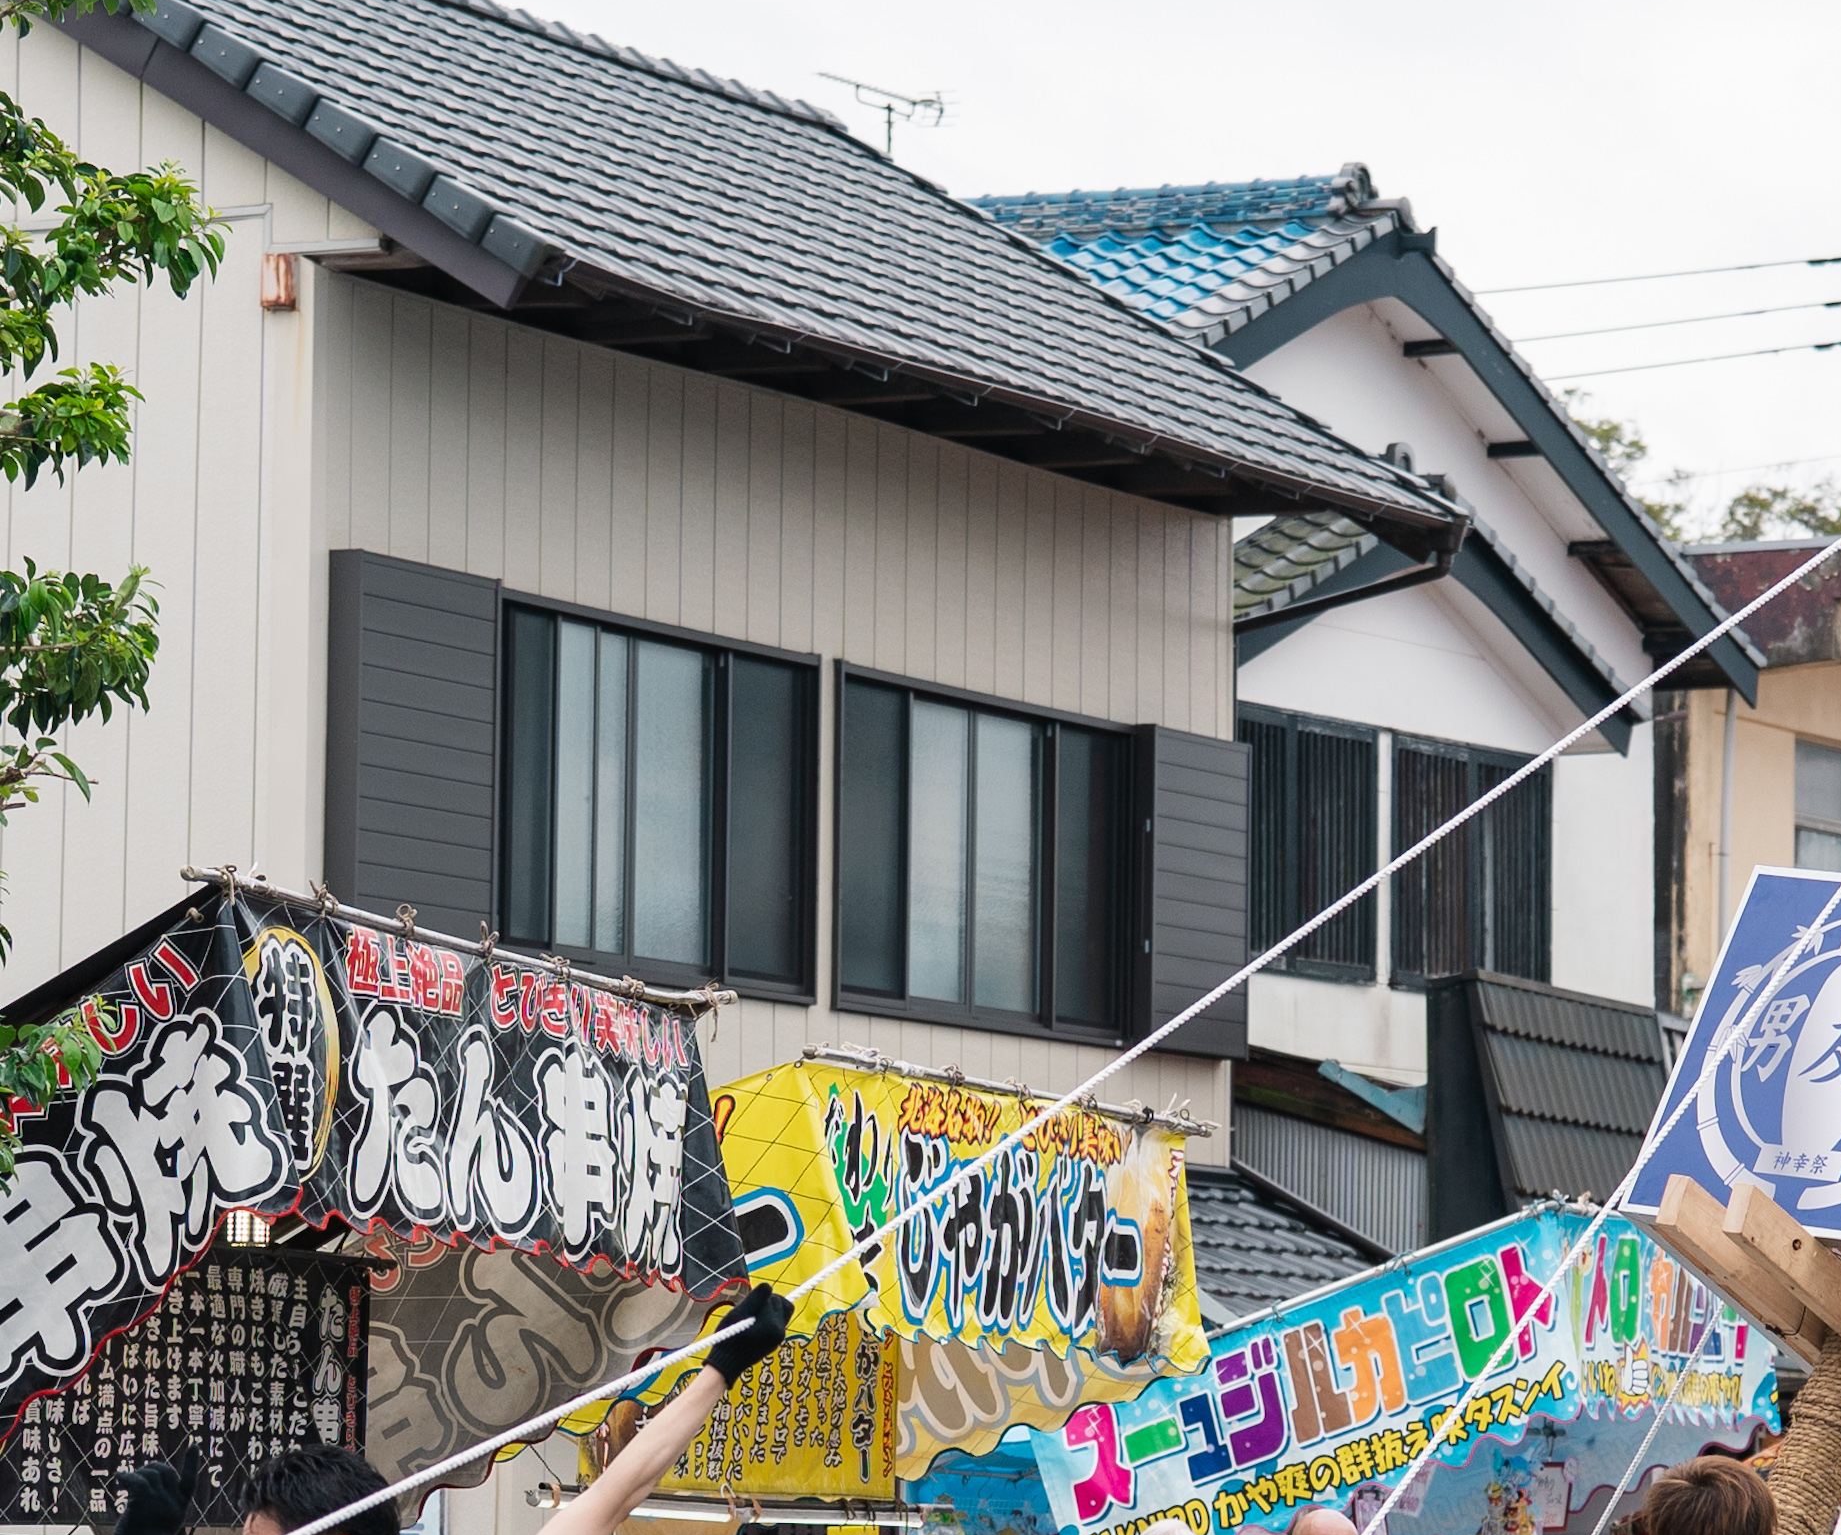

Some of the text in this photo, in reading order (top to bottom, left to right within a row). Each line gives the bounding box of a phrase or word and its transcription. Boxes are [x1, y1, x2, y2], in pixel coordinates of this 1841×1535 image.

[345, 926, 465, 1021] 極上絶品
[348, 1004, 692, 1280] たん串焼
[1772, 1150, 1830, 1175] 神幸祭
[166, 1274, 186, 1431] き上げます
[206, 1264, 226, 1488] 最適な火加減にて
[226, 1266, 246, 1432] 専門の職人が
[769, 1340, 796, 1466] 型のセイロで
[850, 1328, 882, 1483] がバター
[706, 1386, 732, 1482] 相性抜群
